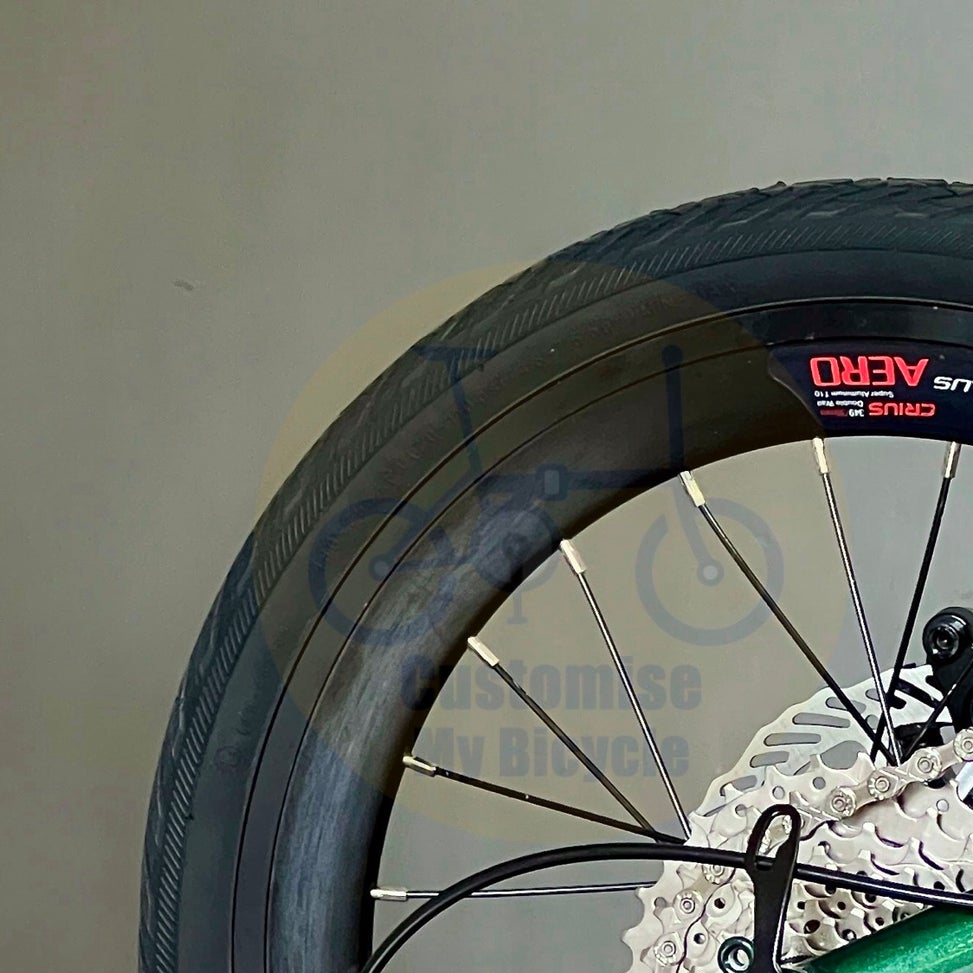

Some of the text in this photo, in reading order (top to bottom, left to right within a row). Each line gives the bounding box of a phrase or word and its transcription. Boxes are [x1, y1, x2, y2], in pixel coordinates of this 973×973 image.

[810, 356, 929, 387] AERO
[870, 390, 895, 399] Super
[836, 399, 863, 408] Double
[849, 407, 865, 418] 349
[868, 402, 936, 417] CRIUS
